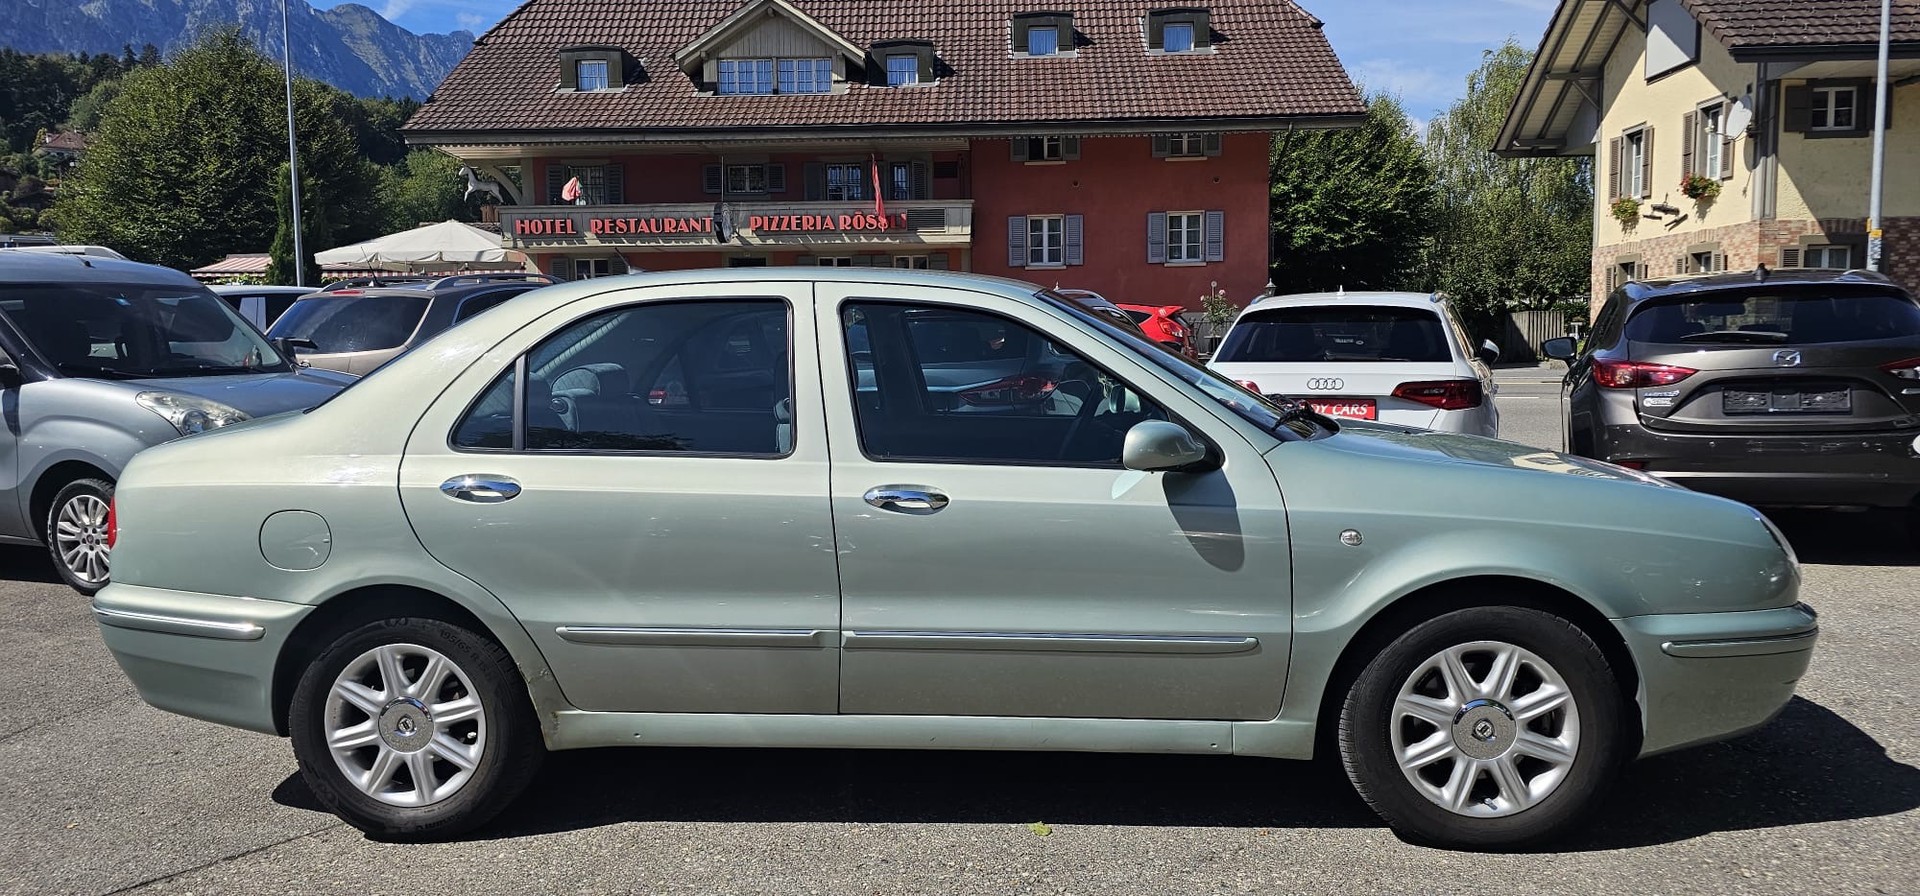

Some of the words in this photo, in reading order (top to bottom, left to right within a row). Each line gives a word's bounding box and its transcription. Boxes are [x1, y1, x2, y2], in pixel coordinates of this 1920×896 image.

[515, 218, 577, 235] HOTEL
[590, 216, 713, 234] RESTAURANT
[750, 214, 835, 231] PIZZERIA
[1332, 403, 1369, 416] CARS
